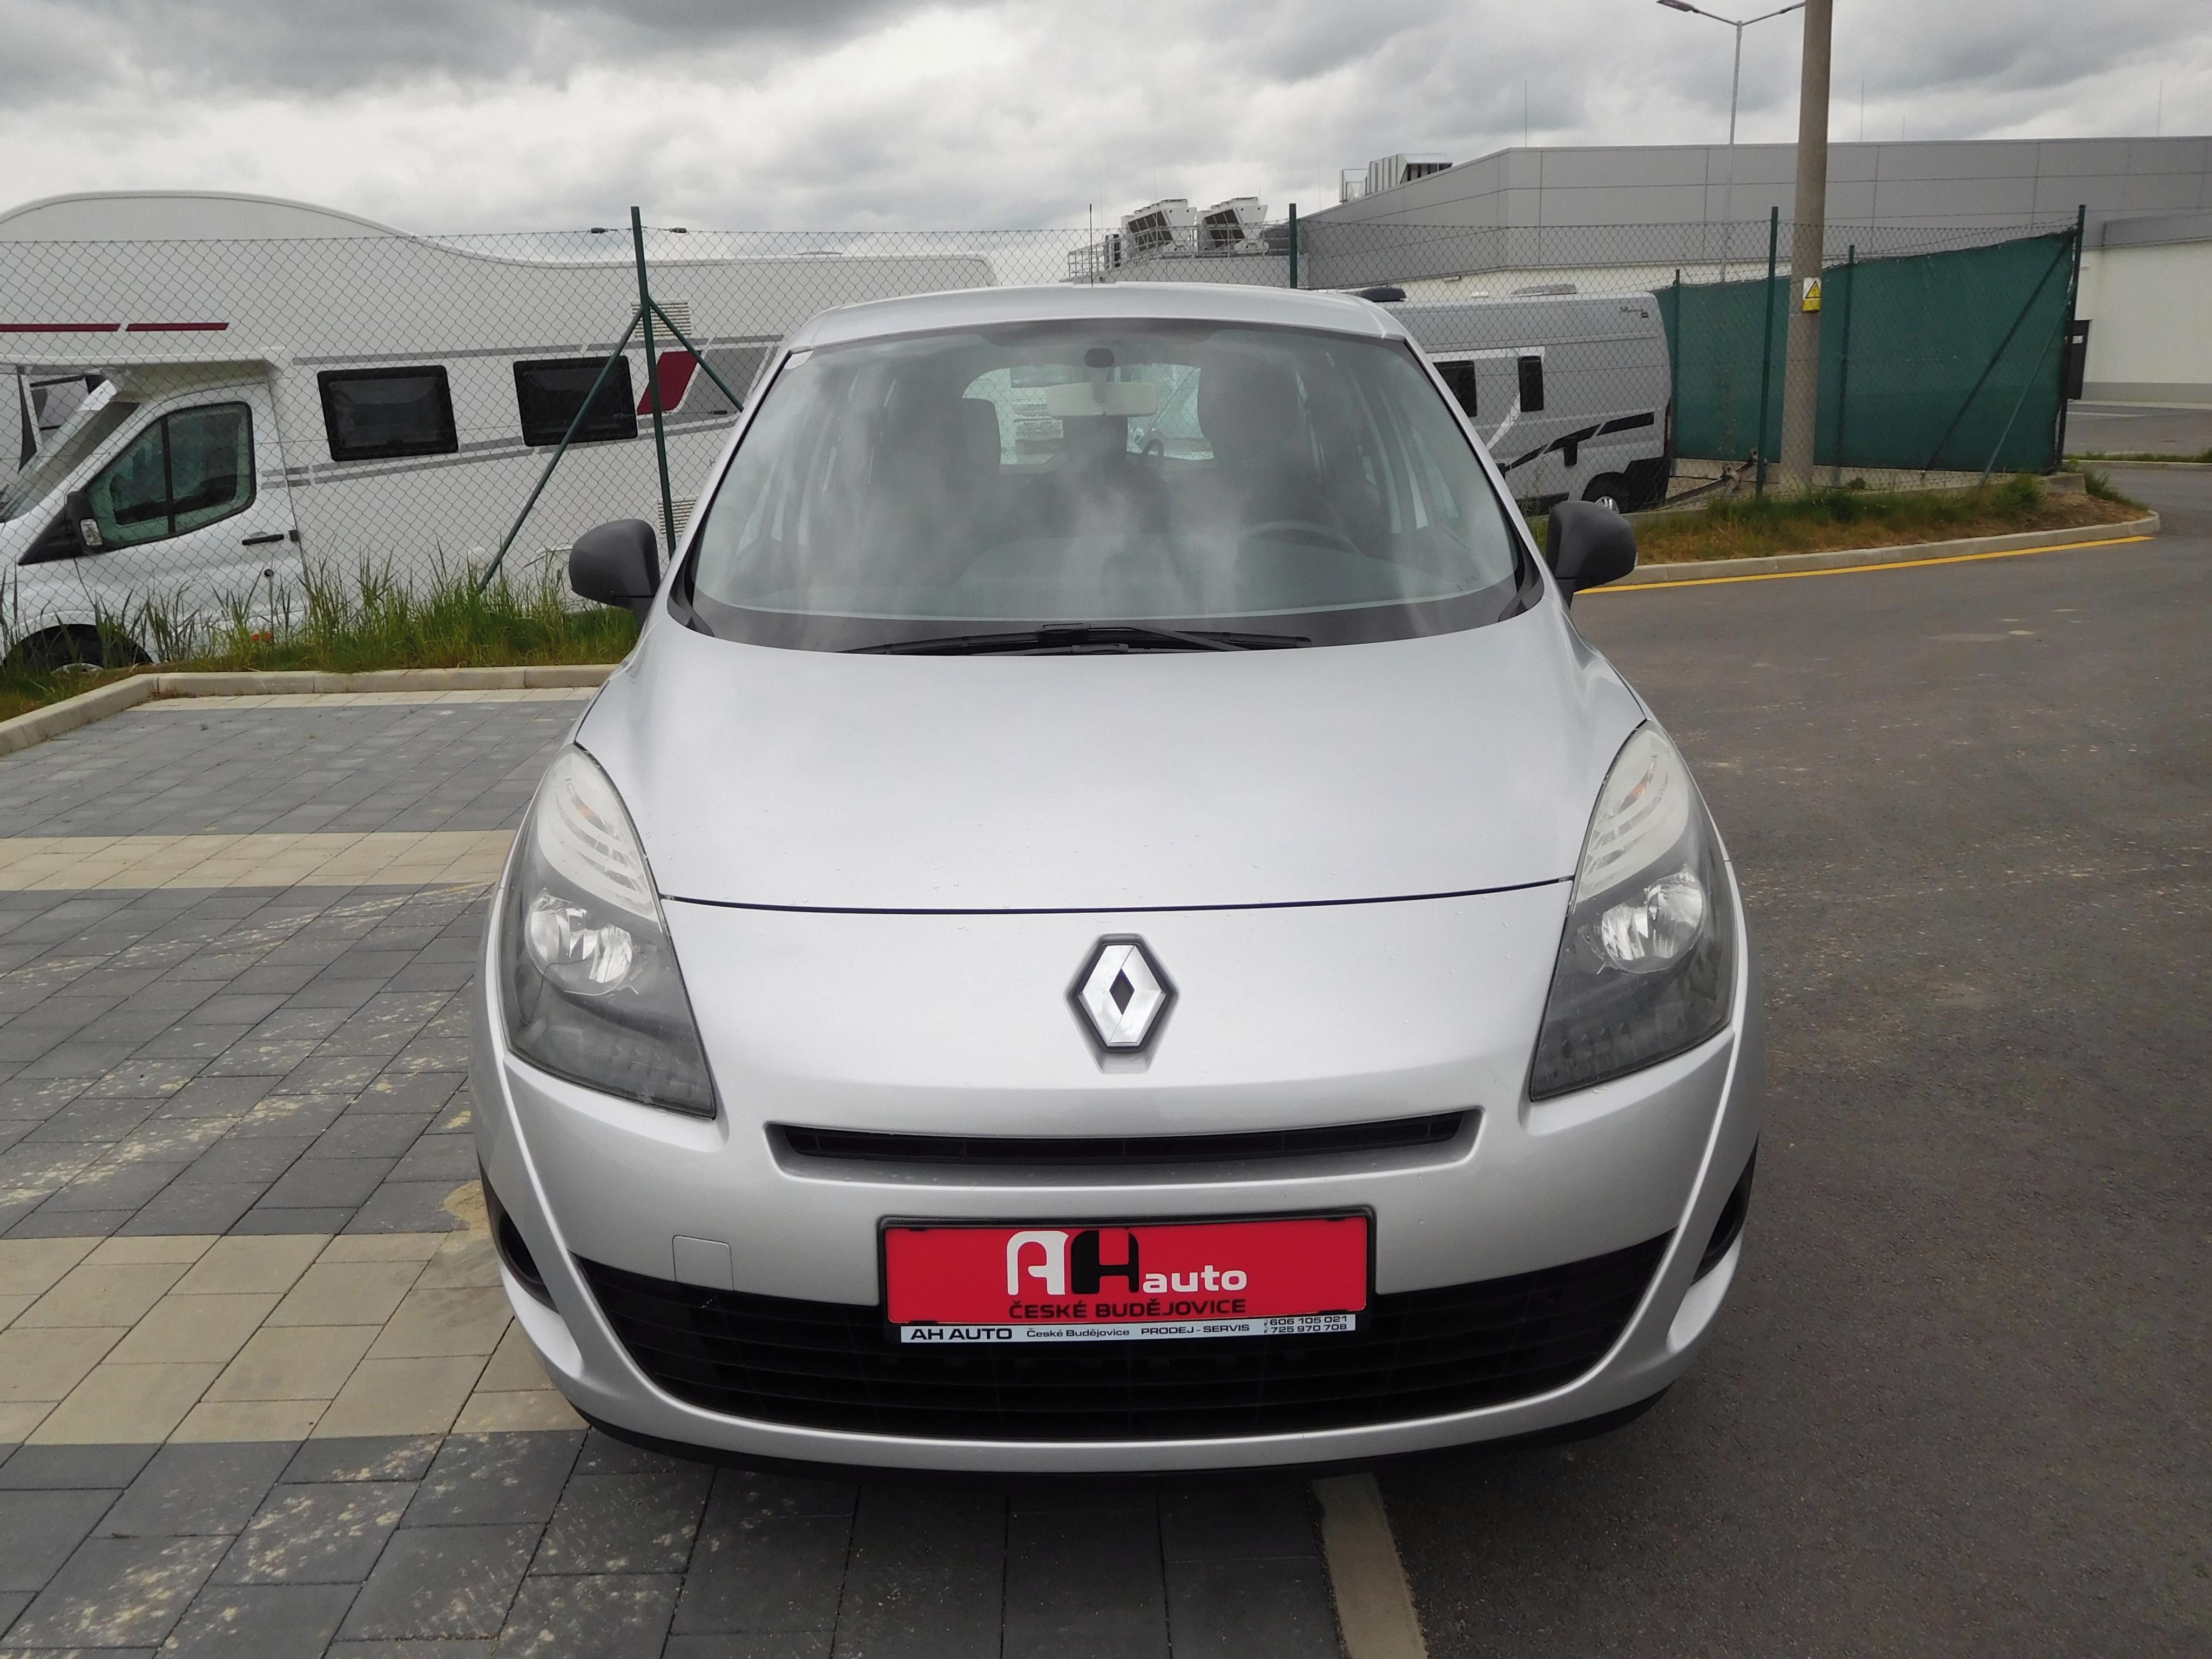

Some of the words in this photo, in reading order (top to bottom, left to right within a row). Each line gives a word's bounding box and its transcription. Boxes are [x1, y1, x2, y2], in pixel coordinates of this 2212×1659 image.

[1009, 1299, 1087, 1319] ČESKÉ
[1095, 1298, 1246, 1318] BUDĚJOVICE
[1270, 1318, 1294, 1326] 606
[910, 1328, 944, 1340] AH
[948, 1328, 1013, 1340] AUTO
[1027, 1327, 1063, 1338] České
[1065, 1328, 1130, 1339] Budějovice
[1271, 1325, 1294, 1333] 725
